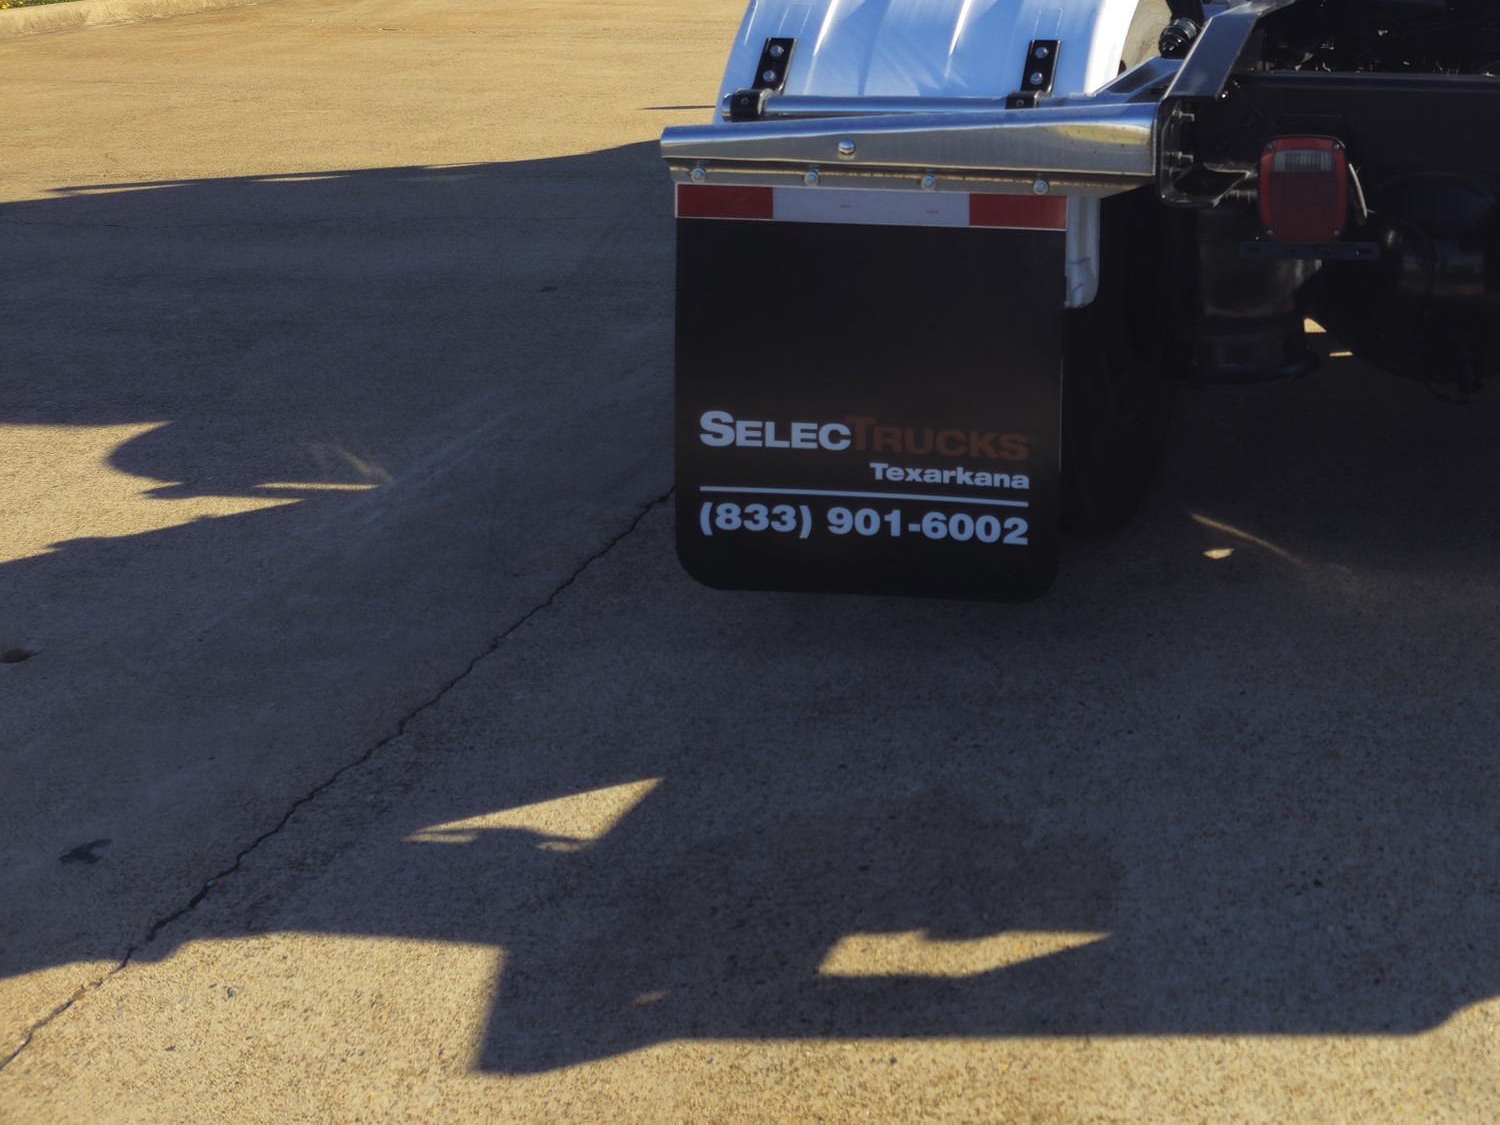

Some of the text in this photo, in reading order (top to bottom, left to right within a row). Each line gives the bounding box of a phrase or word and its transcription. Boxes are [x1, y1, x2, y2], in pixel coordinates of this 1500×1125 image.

[870, 462, 1030, 489] Texarkana
[699, 501, 1029, 546] (833) 901-6002
